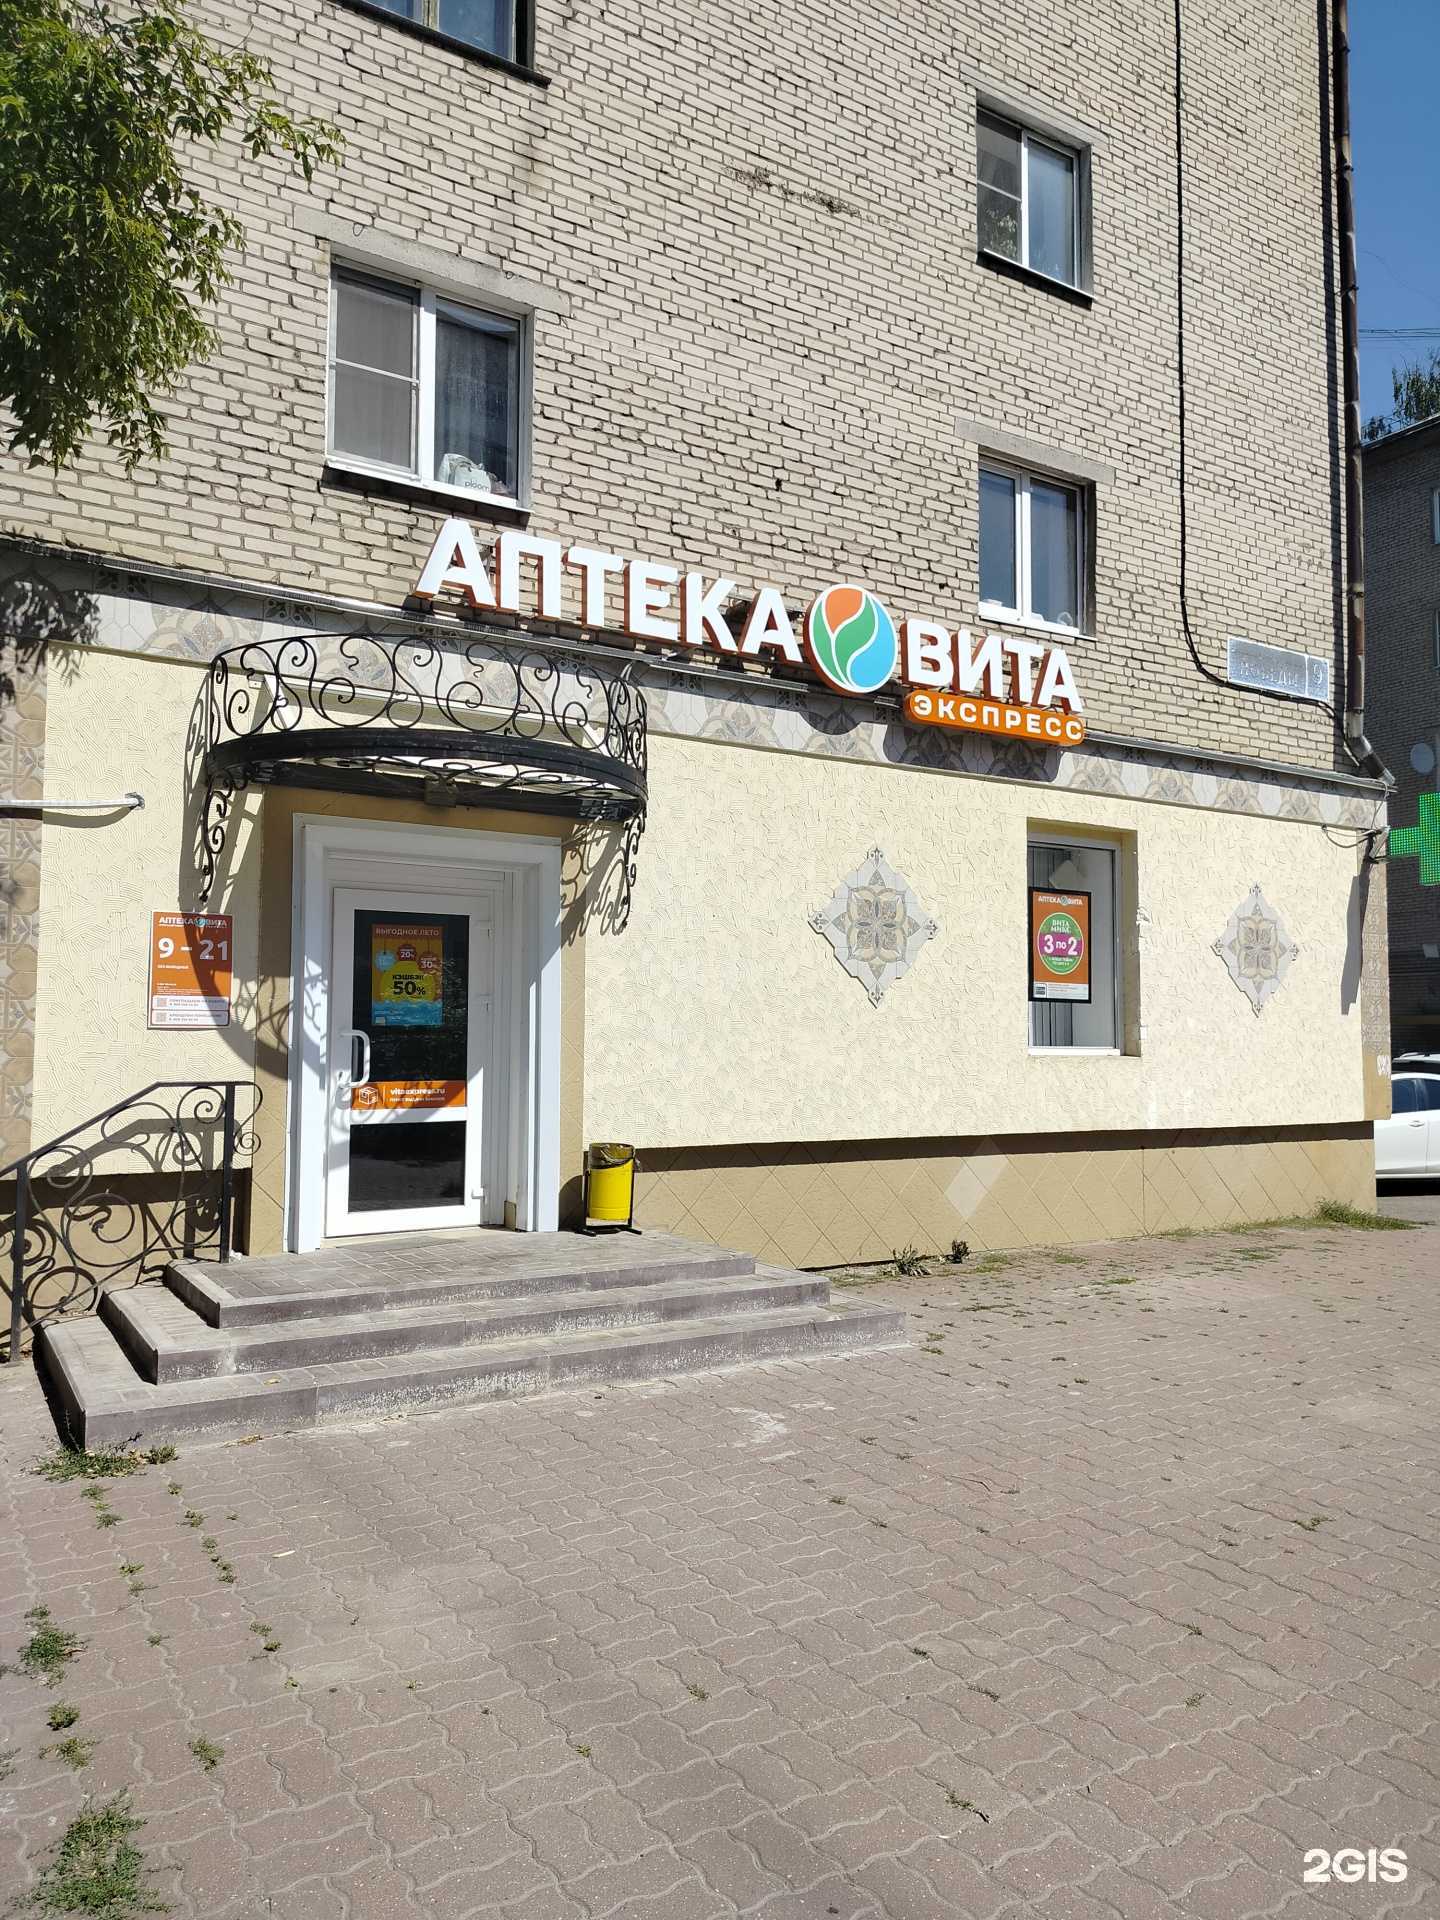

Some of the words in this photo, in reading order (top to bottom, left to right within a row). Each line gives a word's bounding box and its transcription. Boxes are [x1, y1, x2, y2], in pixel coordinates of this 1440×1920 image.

[414, 517, 804, 664] АПТЕКА
[905, 618, 1085, 714] ВИТА
[913, 694, 1083, 741] ЭКСПРЕСС
[1038, 895, 1061, 904] АПТЕКА
[1067, 898, 1083, 906] ВИТА
[158, 916, 194, 925] АПТЕКА
[207, 919, 228, 927] ВИТА
[419, 928, 440, 937] ЛЕТО
[158, 937, 174, 959] 9
[199, 939, 228, 961] 21
[1043, 934, 1055, 954] 3
[1055, 941, 1067, 950] по
[1067, 936, 1078, 956] 2
[393, 980, 426, 996] 50%
